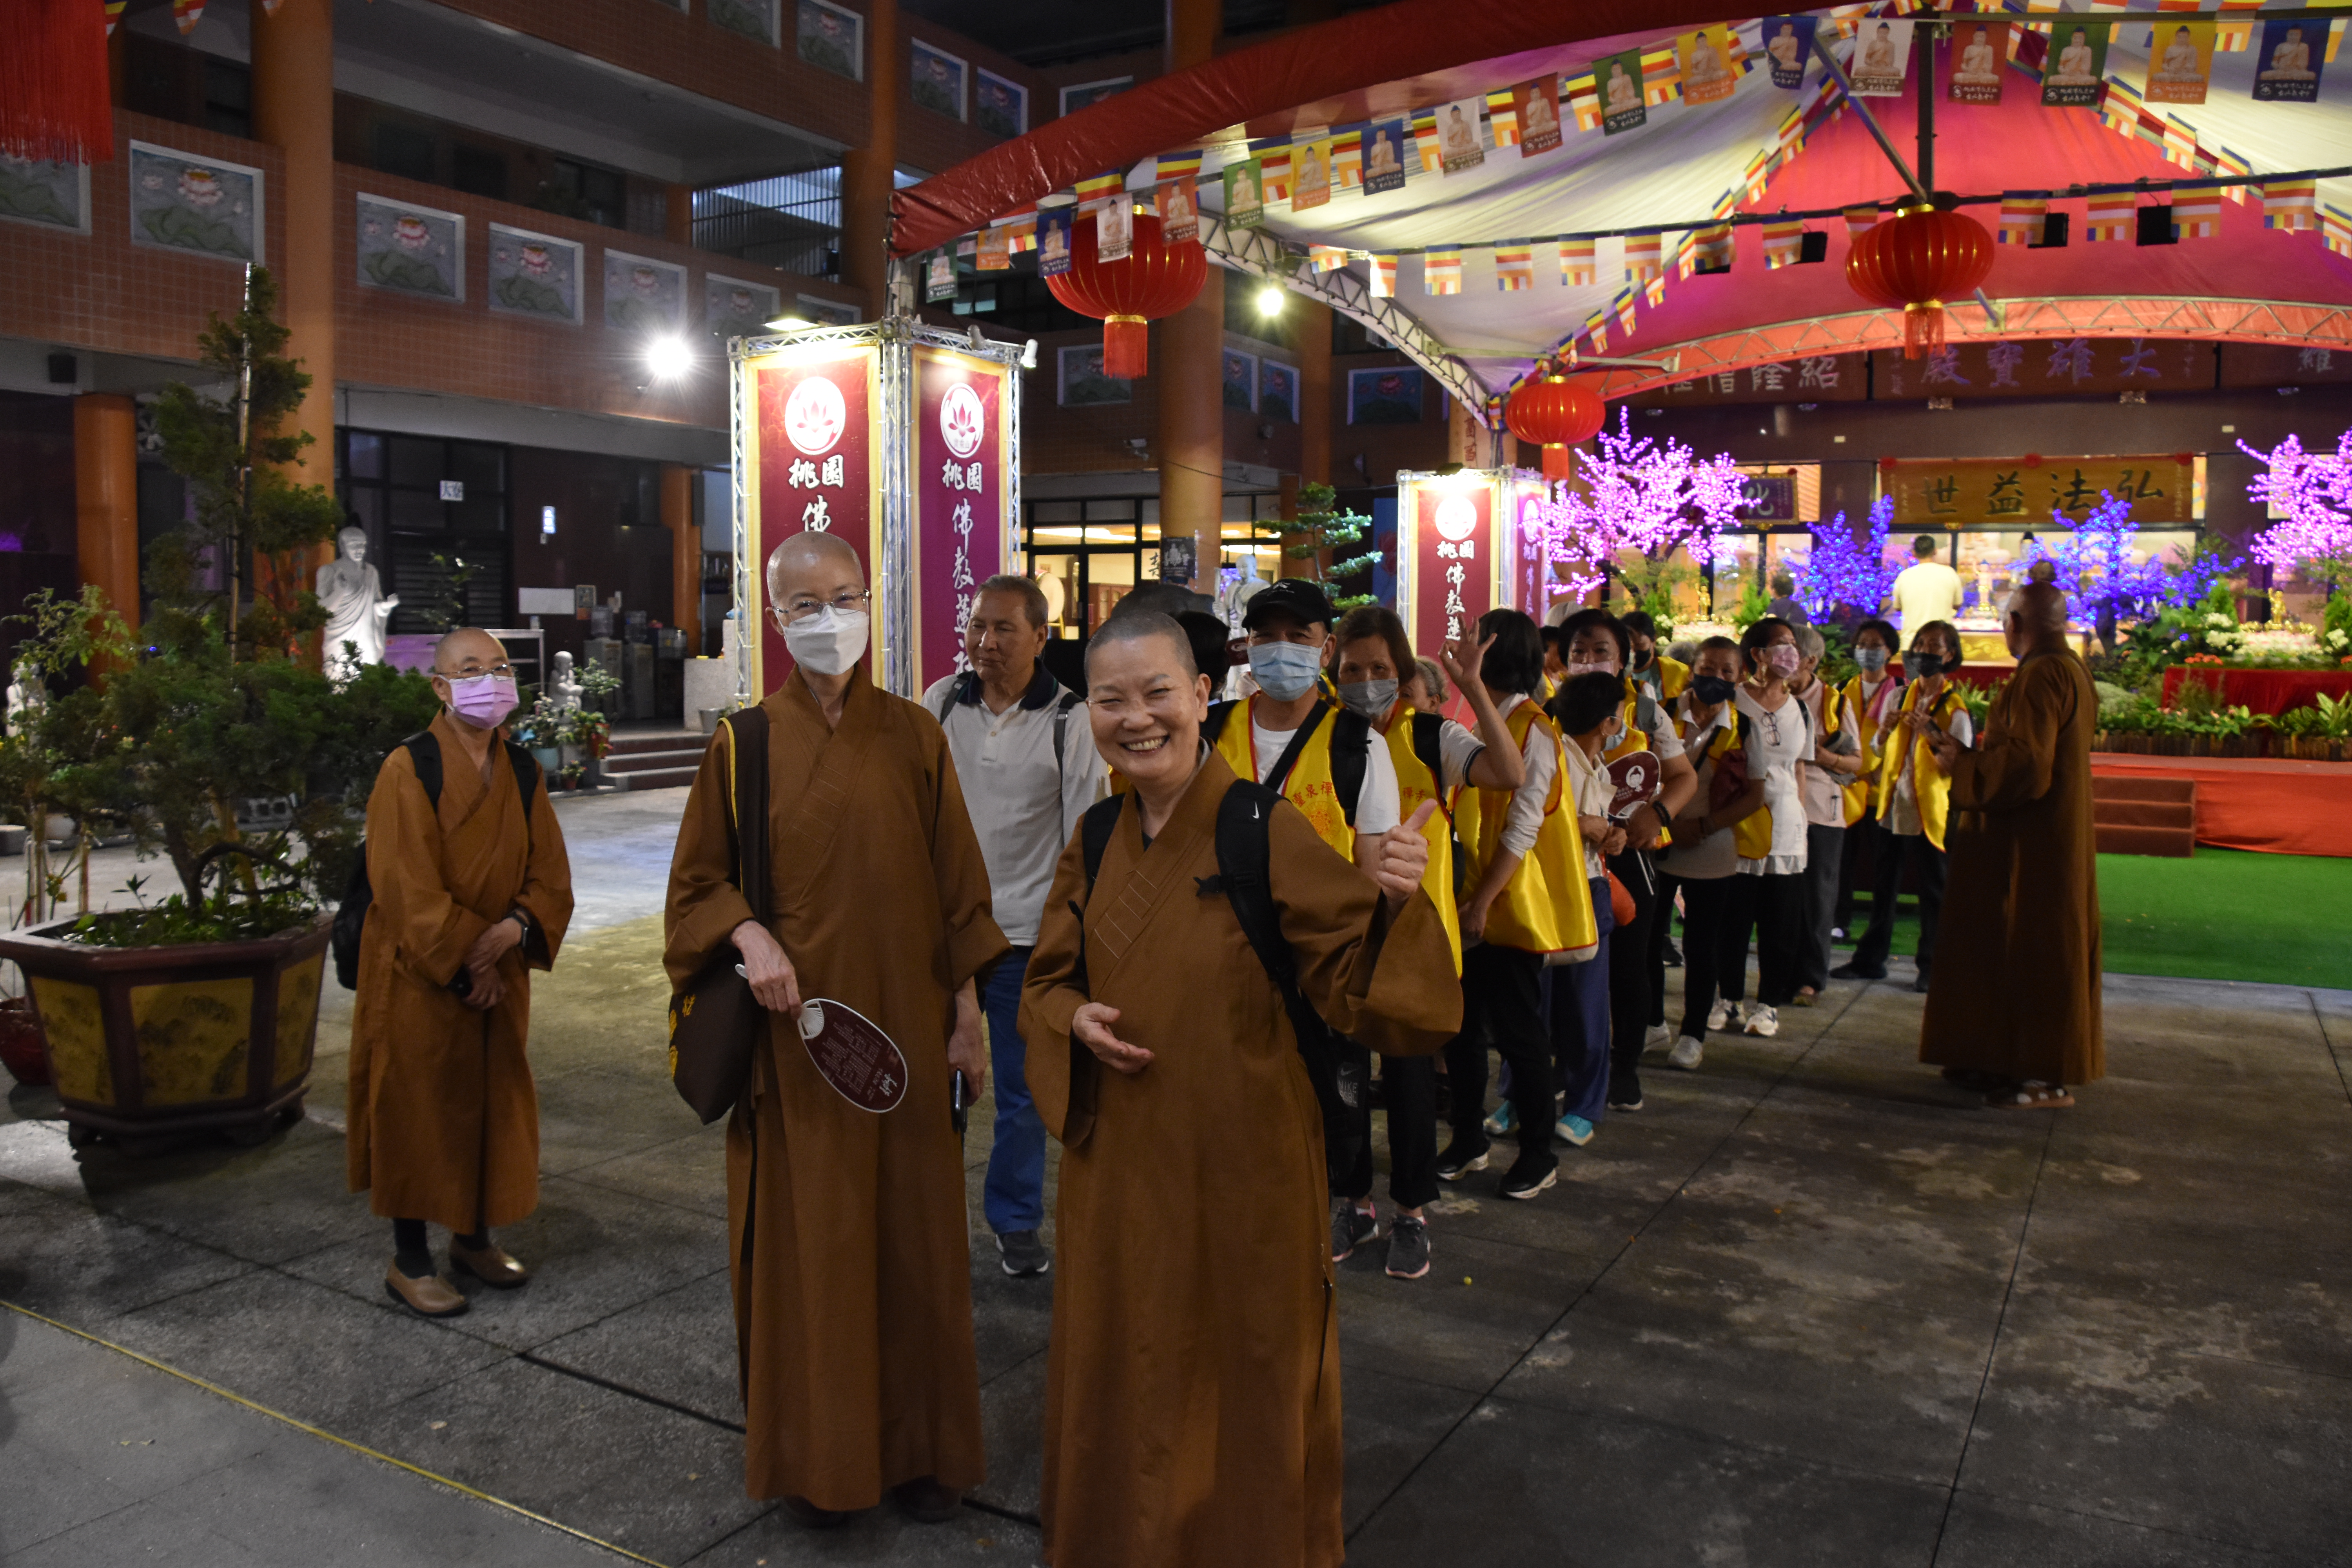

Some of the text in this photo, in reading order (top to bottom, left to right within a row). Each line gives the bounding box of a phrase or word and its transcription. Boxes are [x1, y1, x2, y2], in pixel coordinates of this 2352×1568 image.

[788, 454, 844, 489] 桃園
[942, 458, 982, 494] 桃園
[1922, 468, 2164, 515] 弘法益世
[1437, 540, 1475, 560] 桃園
[1445, 562, 1466, 659] 佛教蓮
[1338, 1080, 1357, 1093] NIKE
